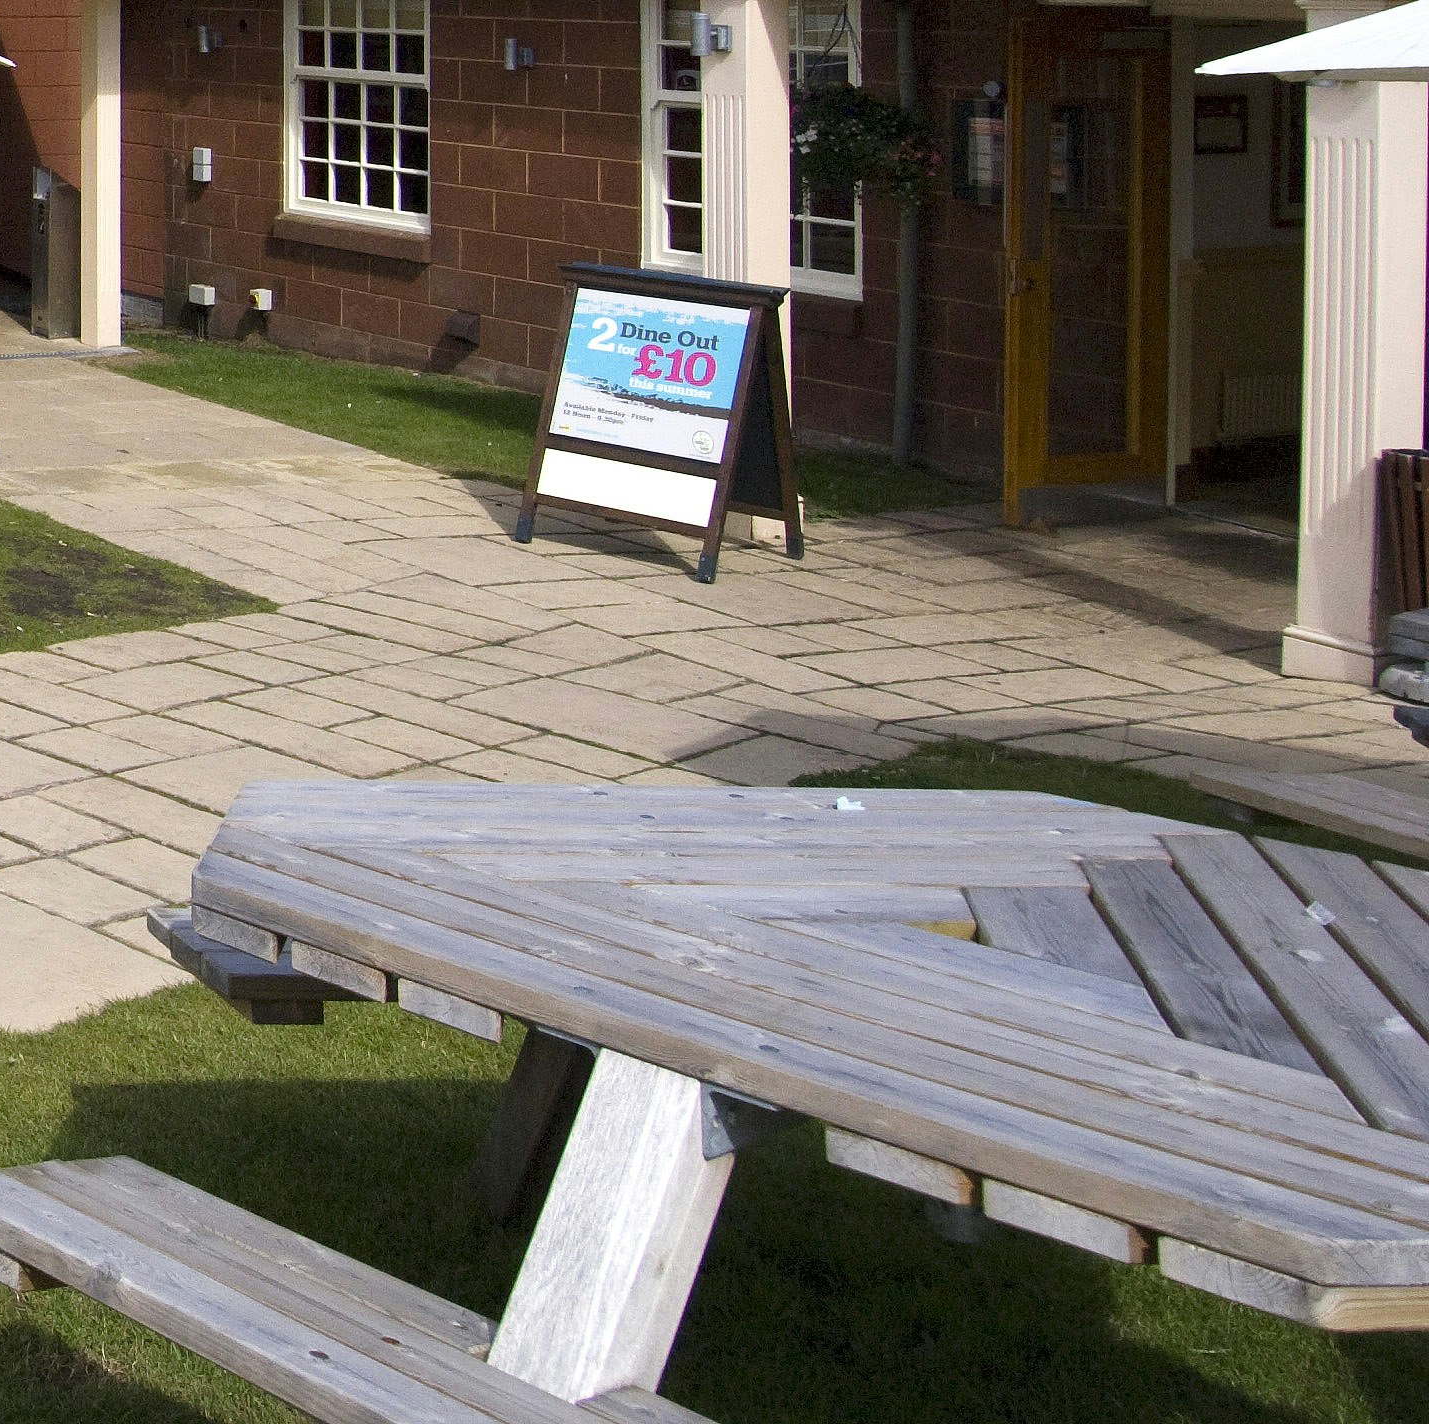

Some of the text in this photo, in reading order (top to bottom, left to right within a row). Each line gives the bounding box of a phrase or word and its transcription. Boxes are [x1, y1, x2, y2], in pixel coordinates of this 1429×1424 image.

[587, 317, 719, 353] 2 Dine Out
[617, 343, 717, 387] for £10
[629, 376, 712, 400] this summer
